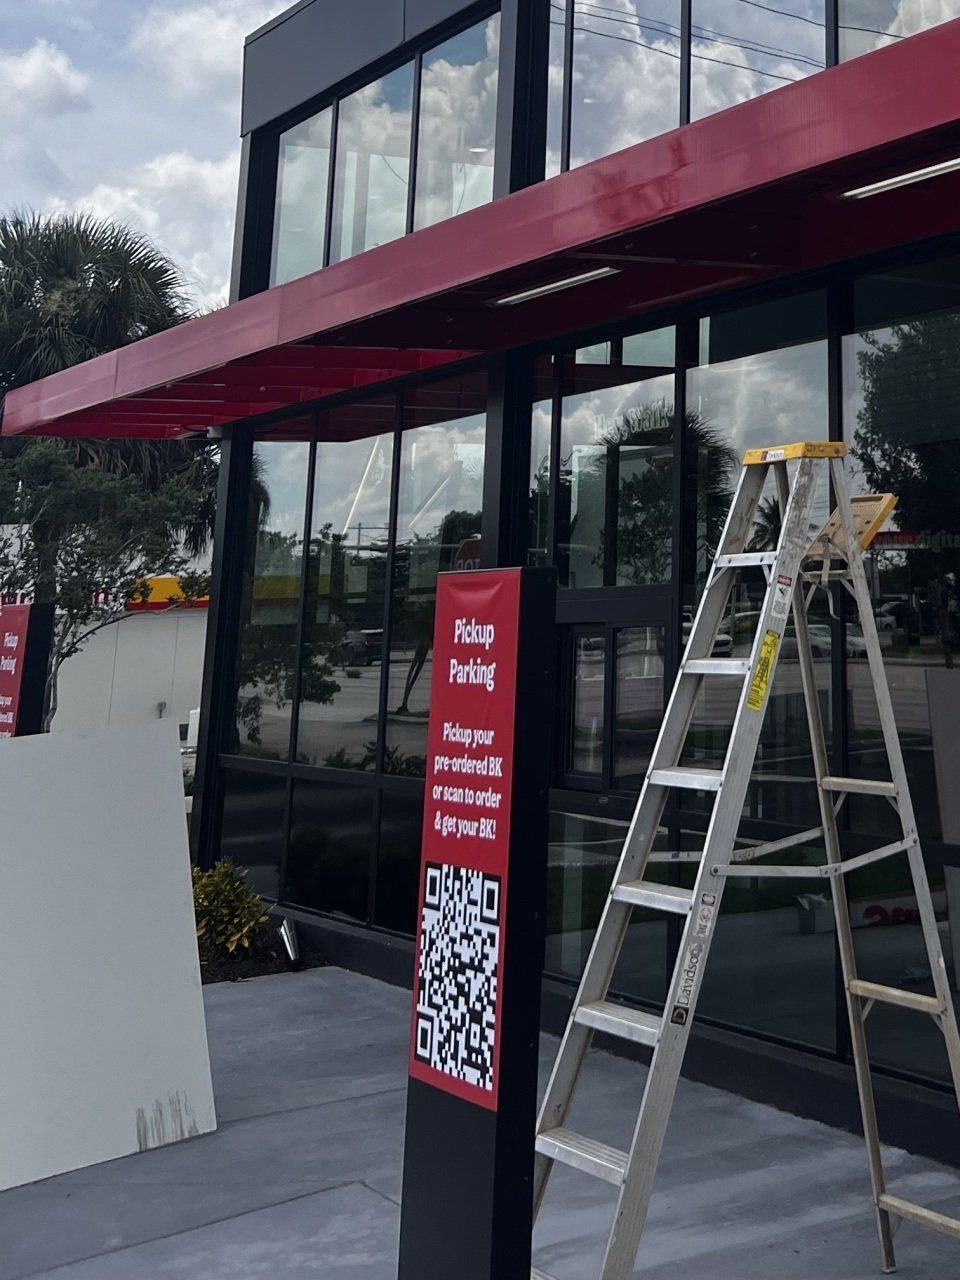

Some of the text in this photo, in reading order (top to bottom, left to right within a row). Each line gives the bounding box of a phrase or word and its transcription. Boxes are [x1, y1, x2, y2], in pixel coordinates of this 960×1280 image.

[454, 617, 495, 650] Pickup
[448, 657, 497, 692] Parking
[443, 721, 495, 749] Pickup your
[433, 753, 503, 777] pre-ordered BK
[432, 784, 502, 809] or scan to order
[434, 810, 497, 840] & get your BK!
